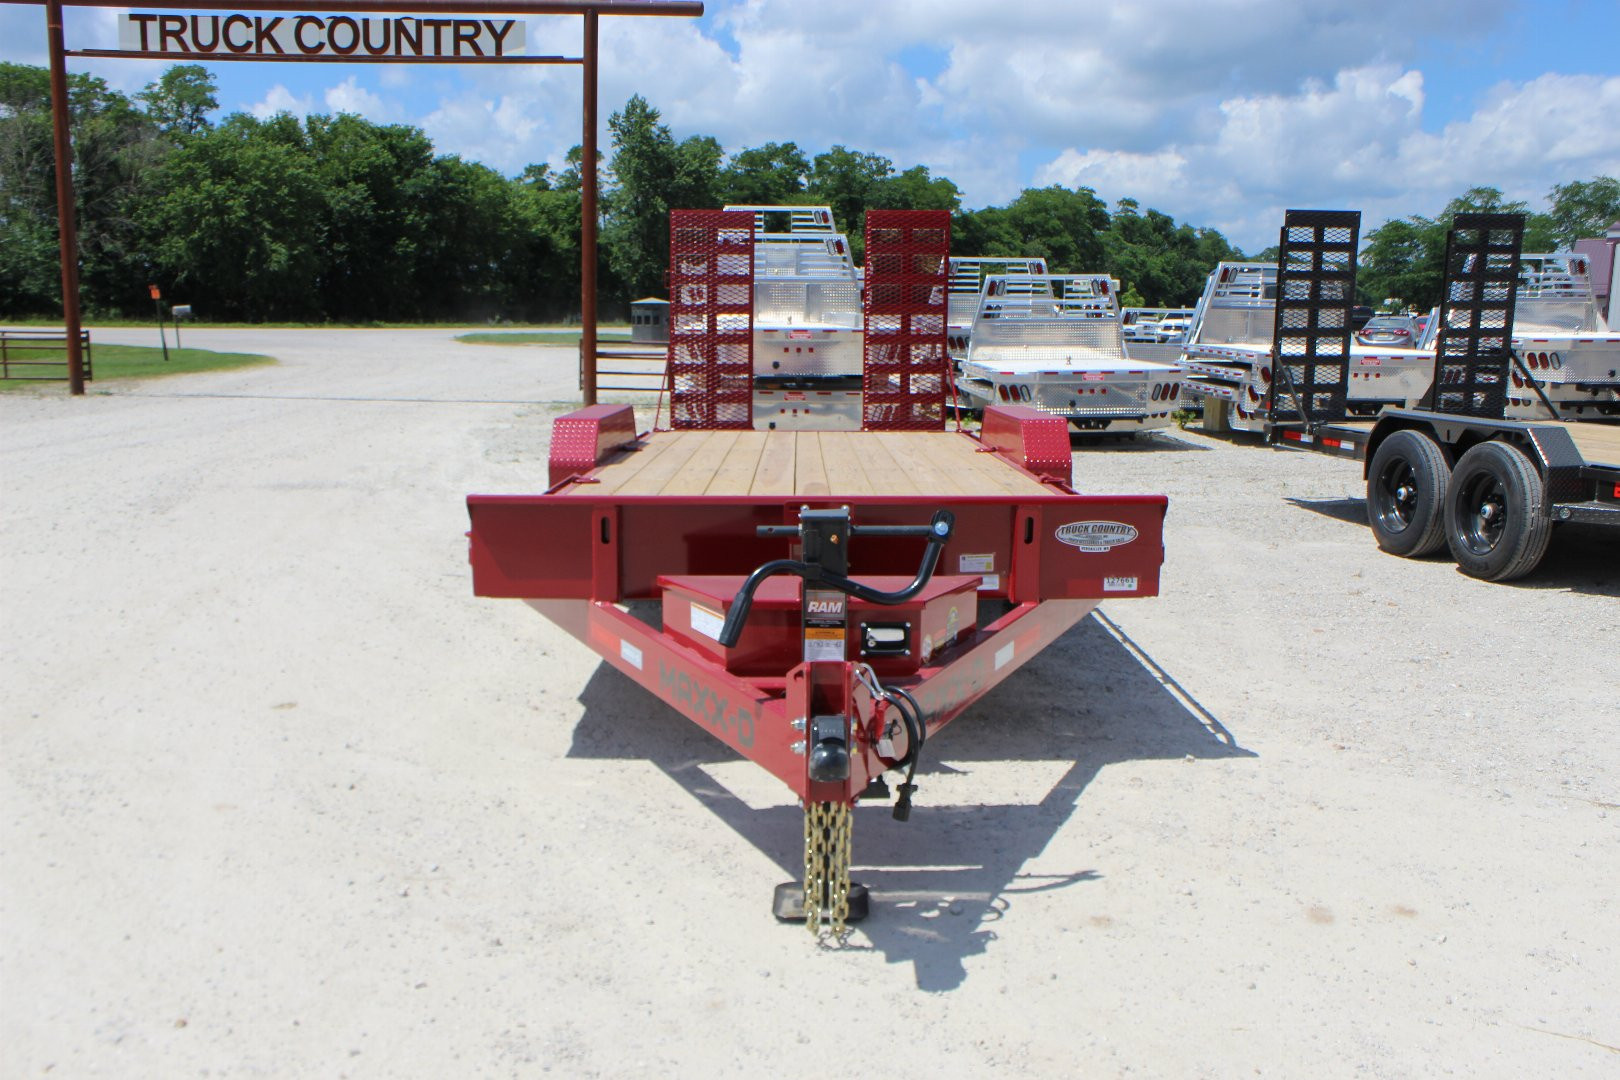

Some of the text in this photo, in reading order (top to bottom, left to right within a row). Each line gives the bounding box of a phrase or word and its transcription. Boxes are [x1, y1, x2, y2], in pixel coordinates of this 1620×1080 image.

[129, 14, 516, 56] TRUCK COUNTRY
[1060, 524, 1132, 535] TRUCK COUNTRY
[807, 600, 843, 613] RAM
[658, 658, 755, 748] MAXX-D
